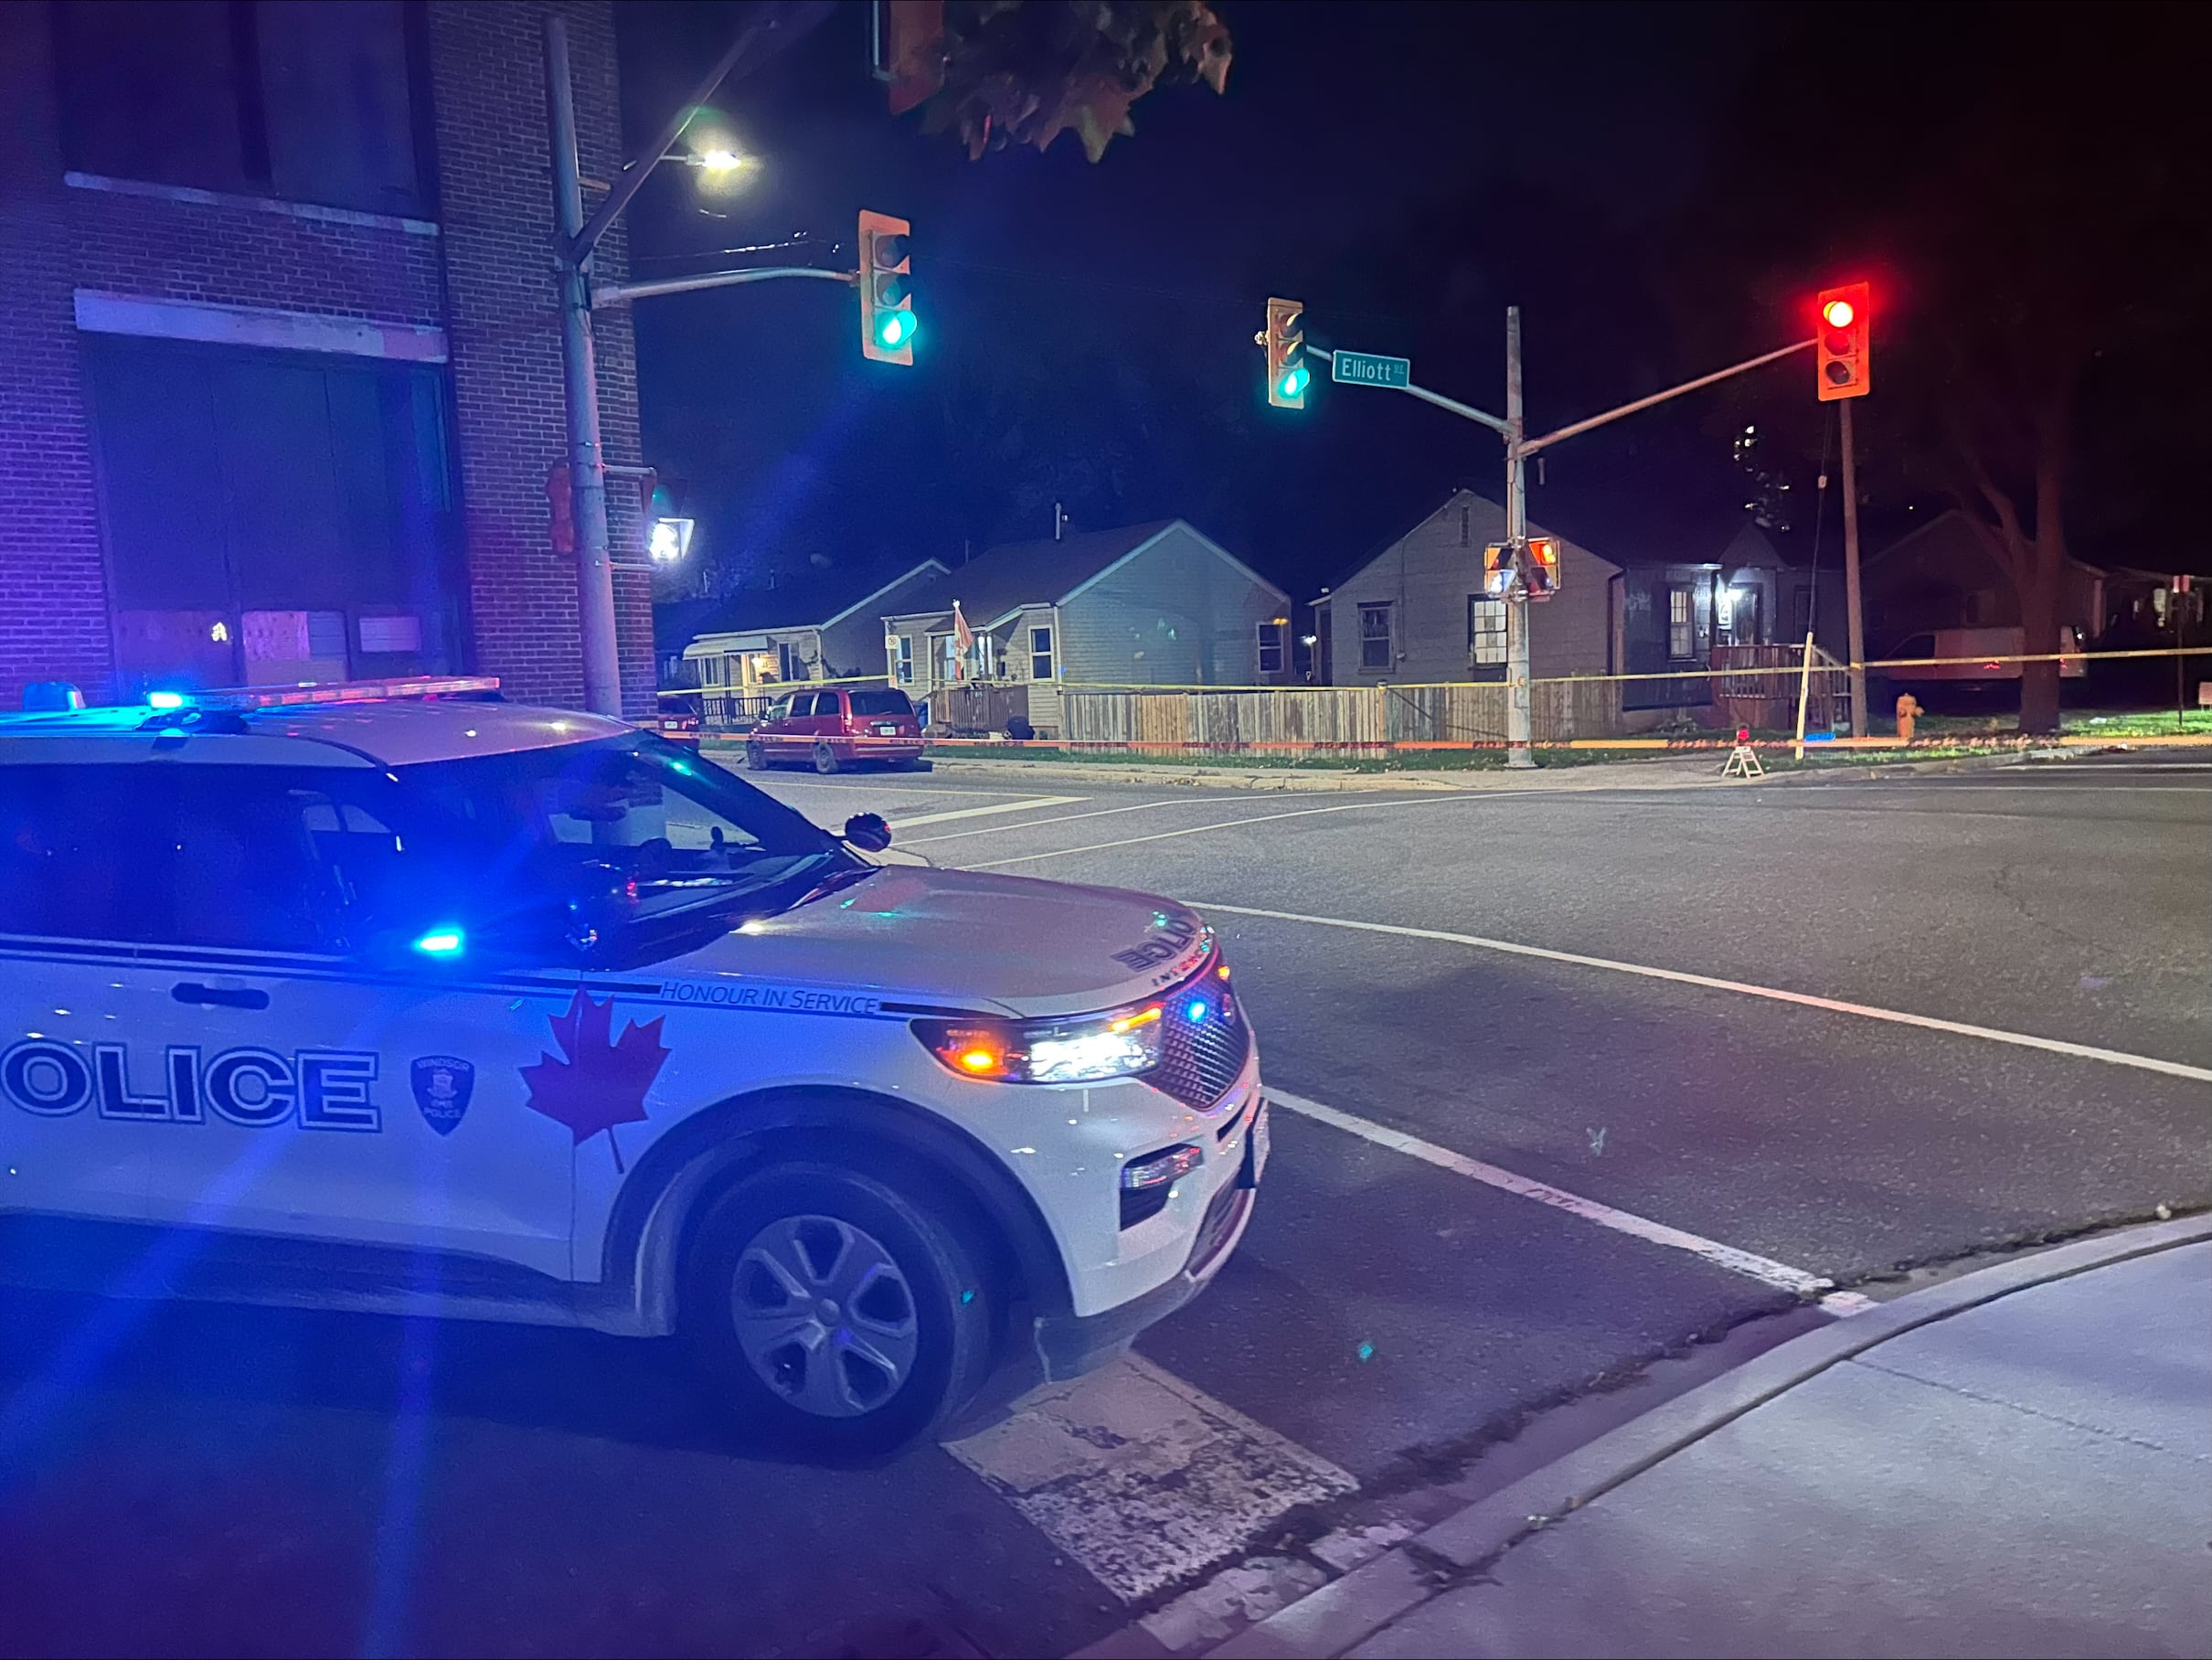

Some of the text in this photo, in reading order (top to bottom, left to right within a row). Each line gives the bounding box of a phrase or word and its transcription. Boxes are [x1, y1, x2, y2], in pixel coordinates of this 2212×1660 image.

[1342, 357, 1391, 381] Elliott
[660, 981, 879, 1015] HONOUR IN SERVICE
[416, 1058, 470, 1071] WINDSOR
[423, 1107, 461, 1119] POLICE
